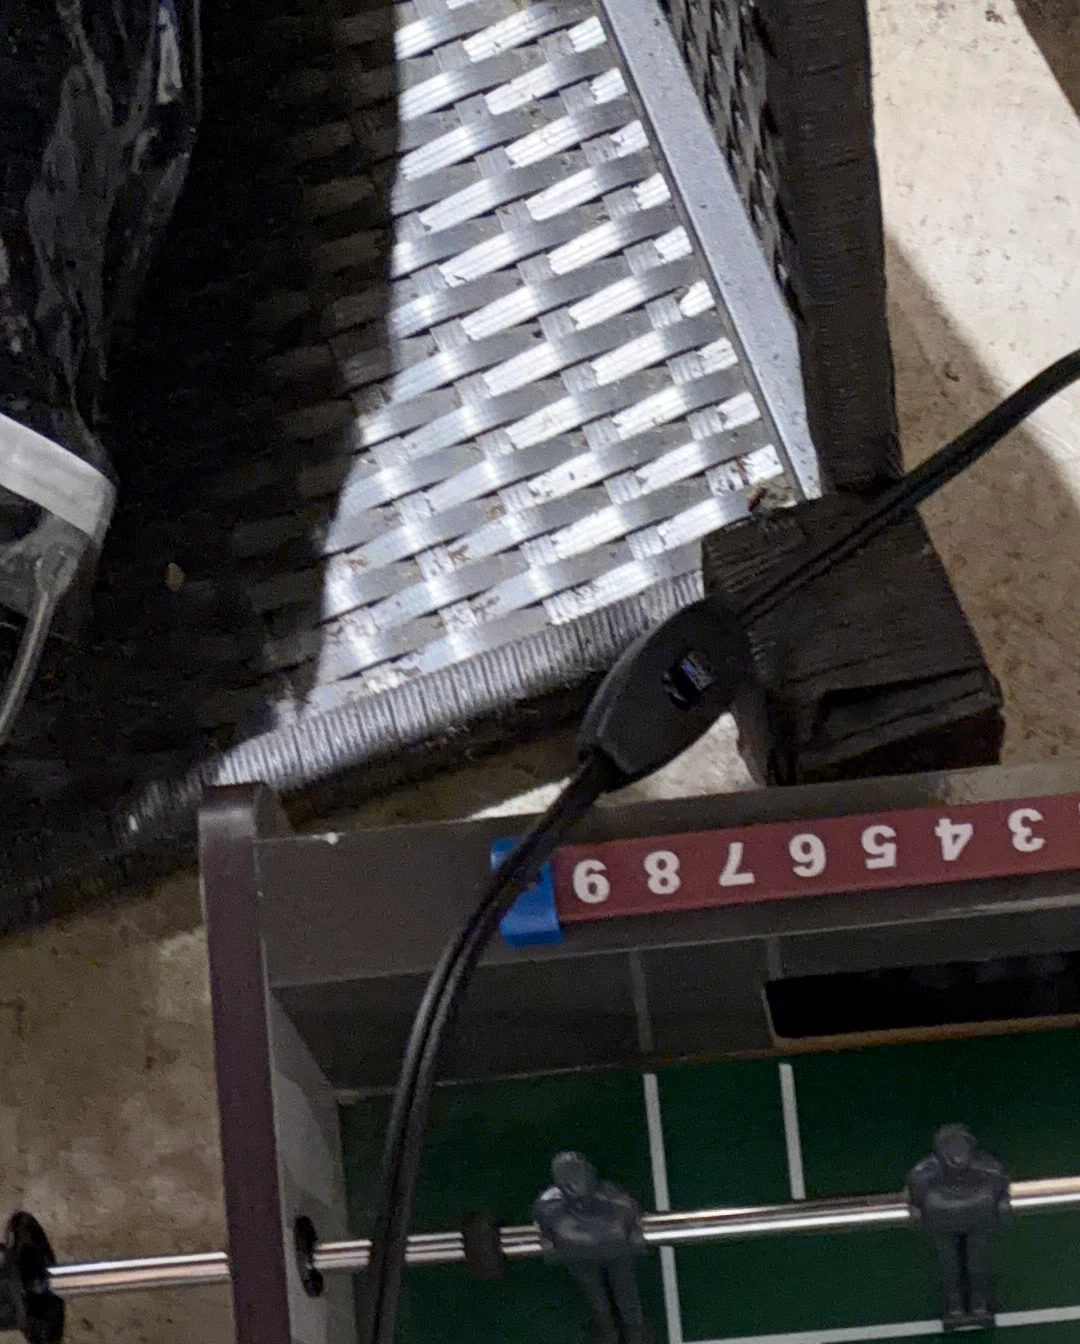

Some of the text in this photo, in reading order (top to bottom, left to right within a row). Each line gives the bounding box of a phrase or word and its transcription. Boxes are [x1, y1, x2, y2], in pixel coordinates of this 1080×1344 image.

[861, 824, 897, 869] 5
[934, 817, 973, 861] 4
[1007, 807, 1045, 852] 3
[643, 850, 681, 895] 8
[718, 842, 755, 887] 7
[789, 833, 826, 877] 6
[573, 859, 610, 904] 9
